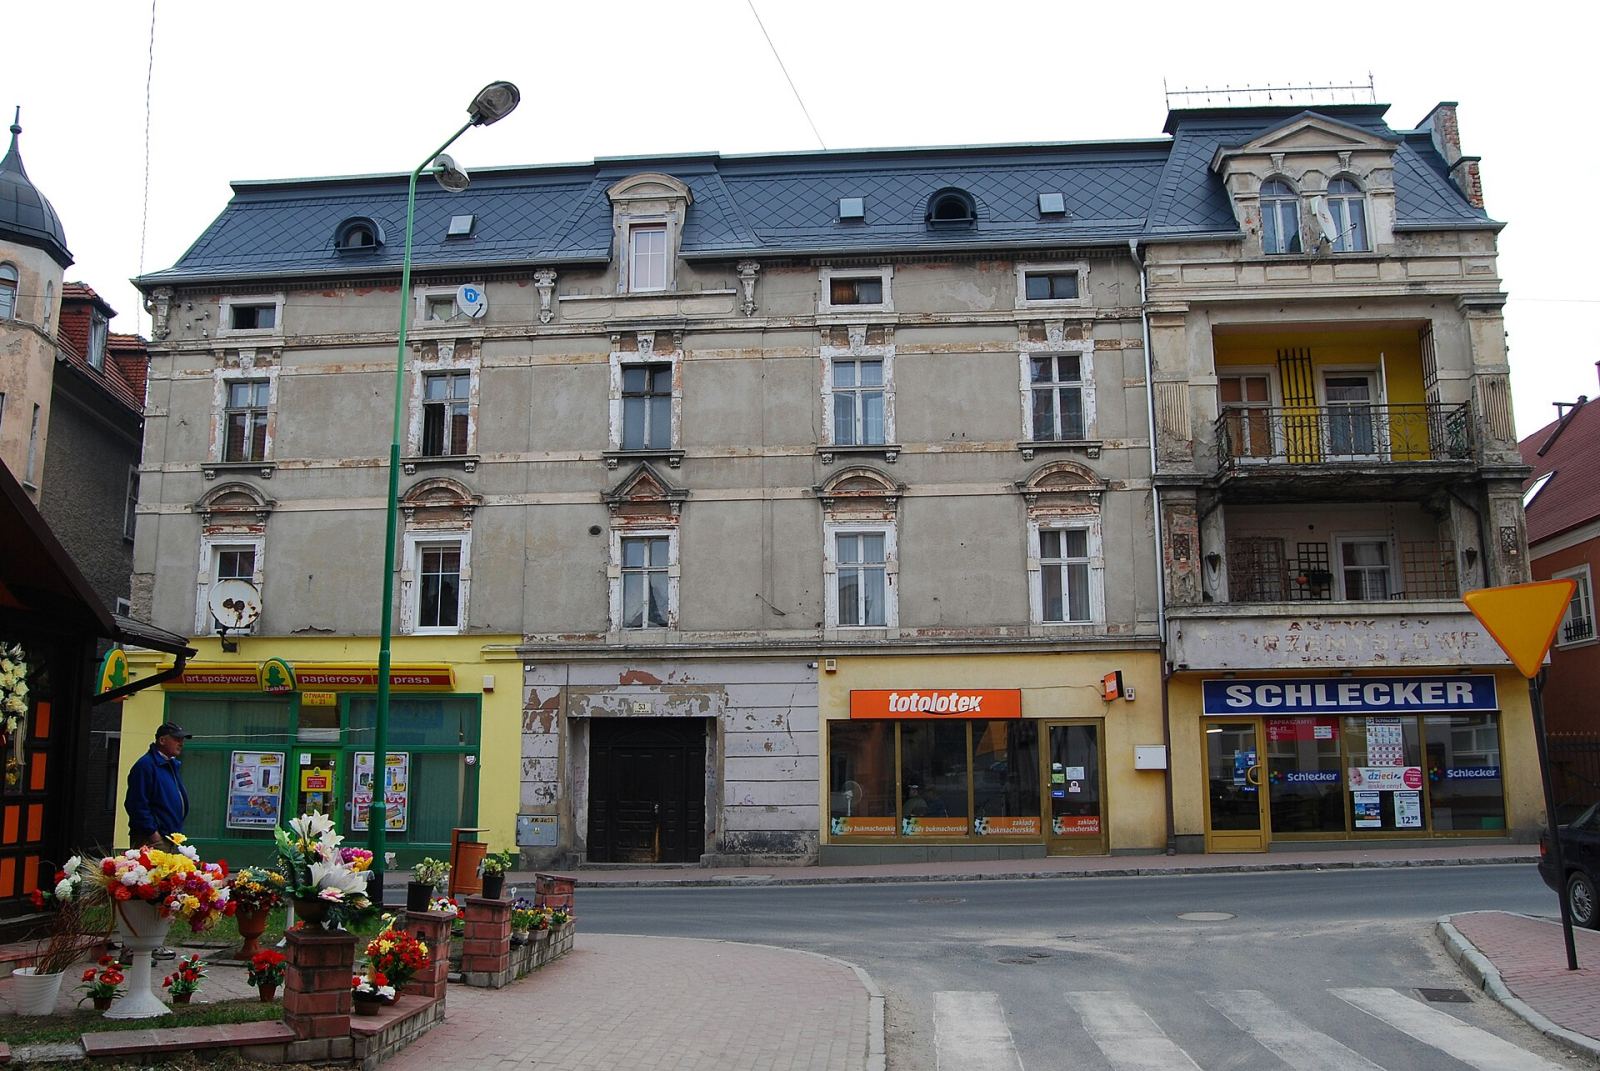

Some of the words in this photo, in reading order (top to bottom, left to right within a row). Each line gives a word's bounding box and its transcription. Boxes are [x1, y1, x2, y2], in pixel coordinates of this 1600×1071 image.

[301, 674, 364, 684] papierosy
[393, 676, 430, 685] prasa
[1225, 681, 1474, 708] SCHLECKER
[888, 692, 983, 712] totolotek
[1287, 772, 1337, 782] Schlecker
[1447, 768, 1497, 778] Schlecker
